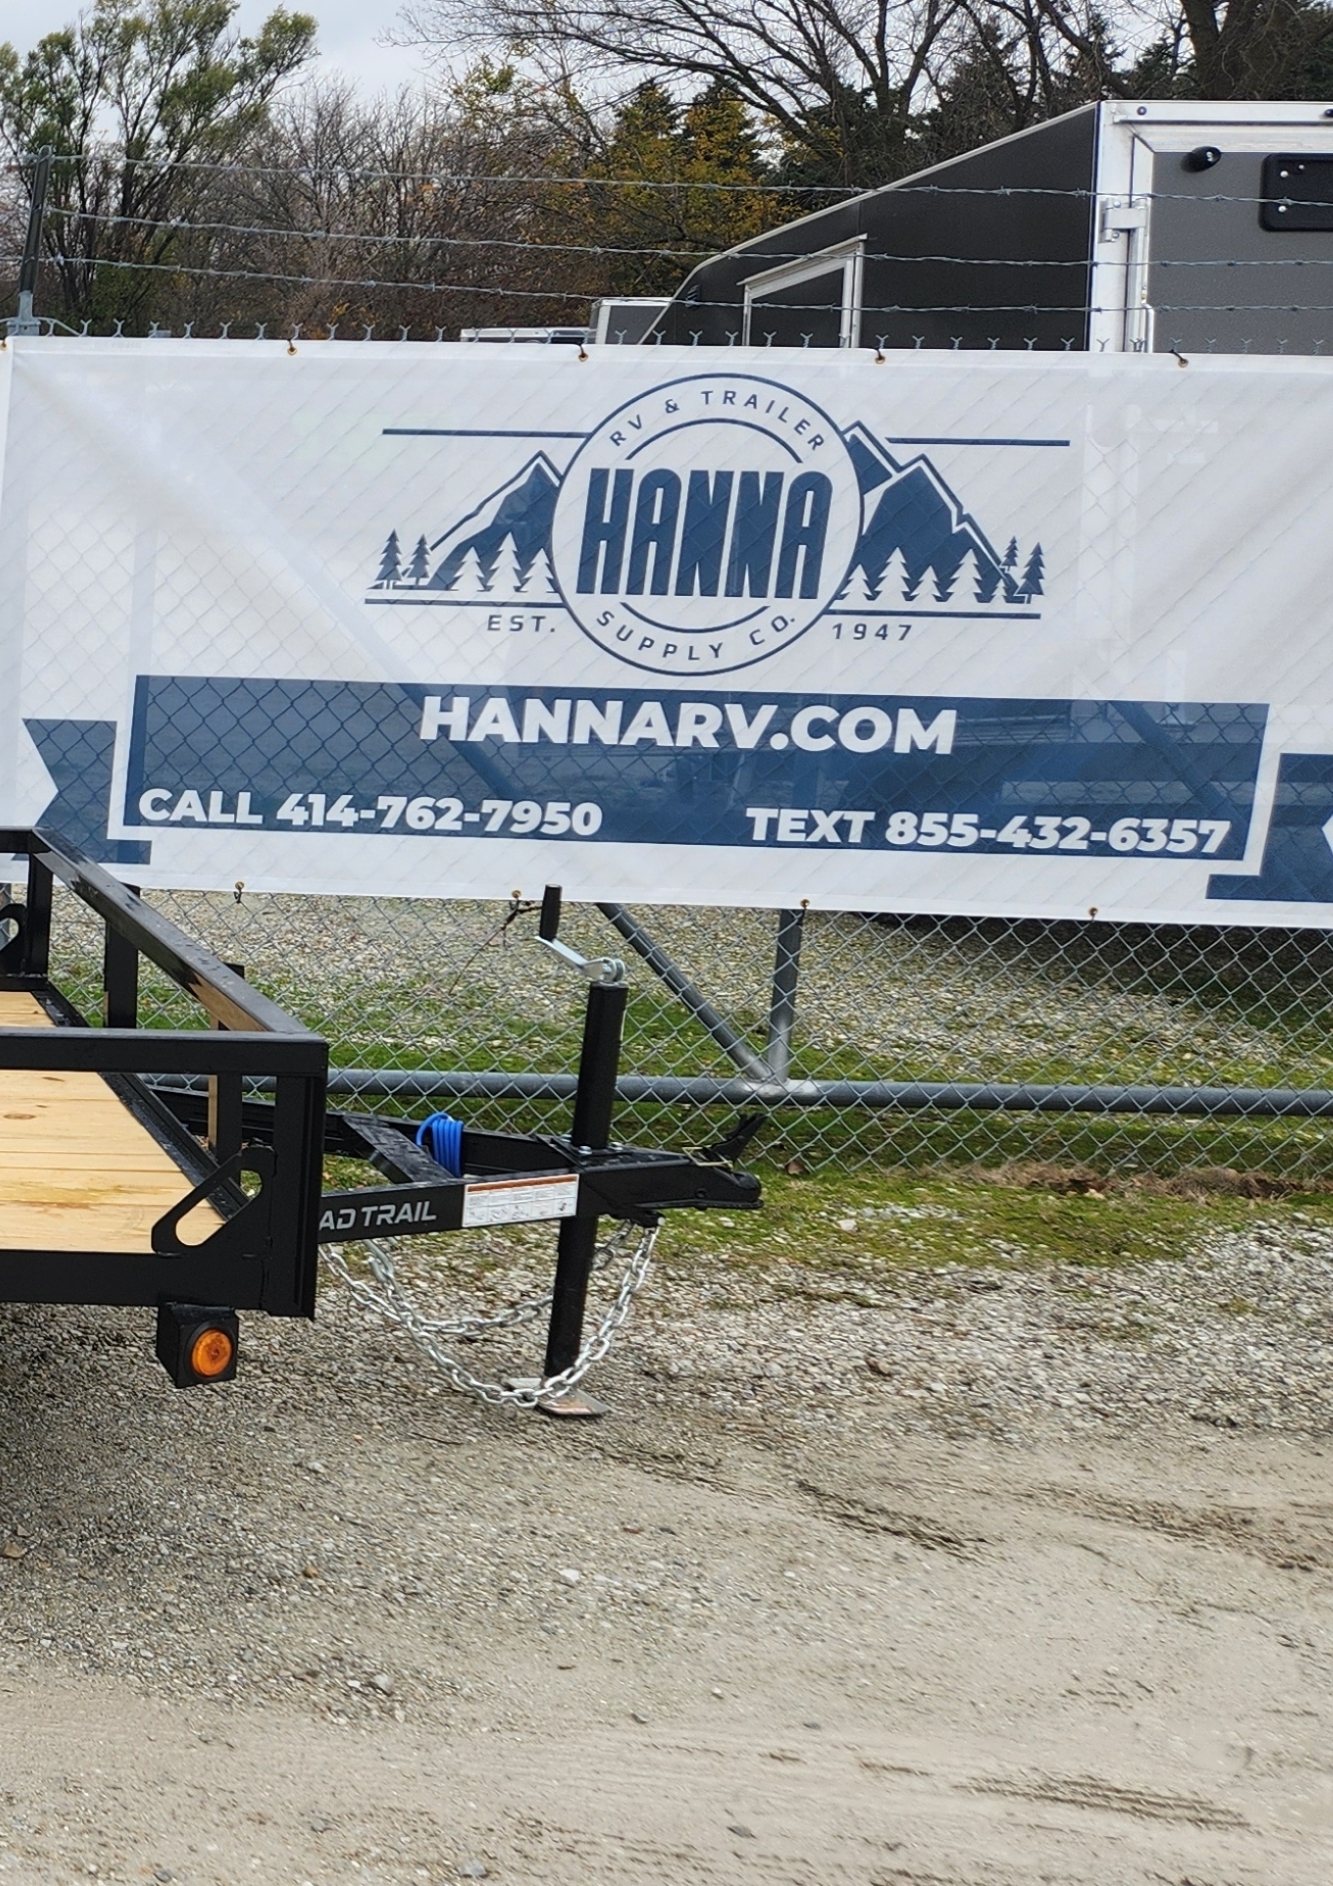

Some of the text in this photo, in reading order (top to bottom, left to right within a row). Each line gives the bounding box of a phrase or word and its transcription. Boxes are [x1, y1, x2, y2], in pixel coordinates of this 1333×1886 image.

[609, 390, 826, 451] RV & TRAILER
[575, 467, 833, 600] HANNA
[487, 615, 556, 633] EST.
[595, 610, 796, 661] SUPPLY CO.
[831, 622, 913, 642] 1947
[419, 695, 958, 756] HANNARV.COM
[138, 788, 603, 837] CALL 414-762-7950
[745, 807, 1231, 854] TEXT 855-432-6357
[319, 1200, 437, 1231] AD TRAIL
